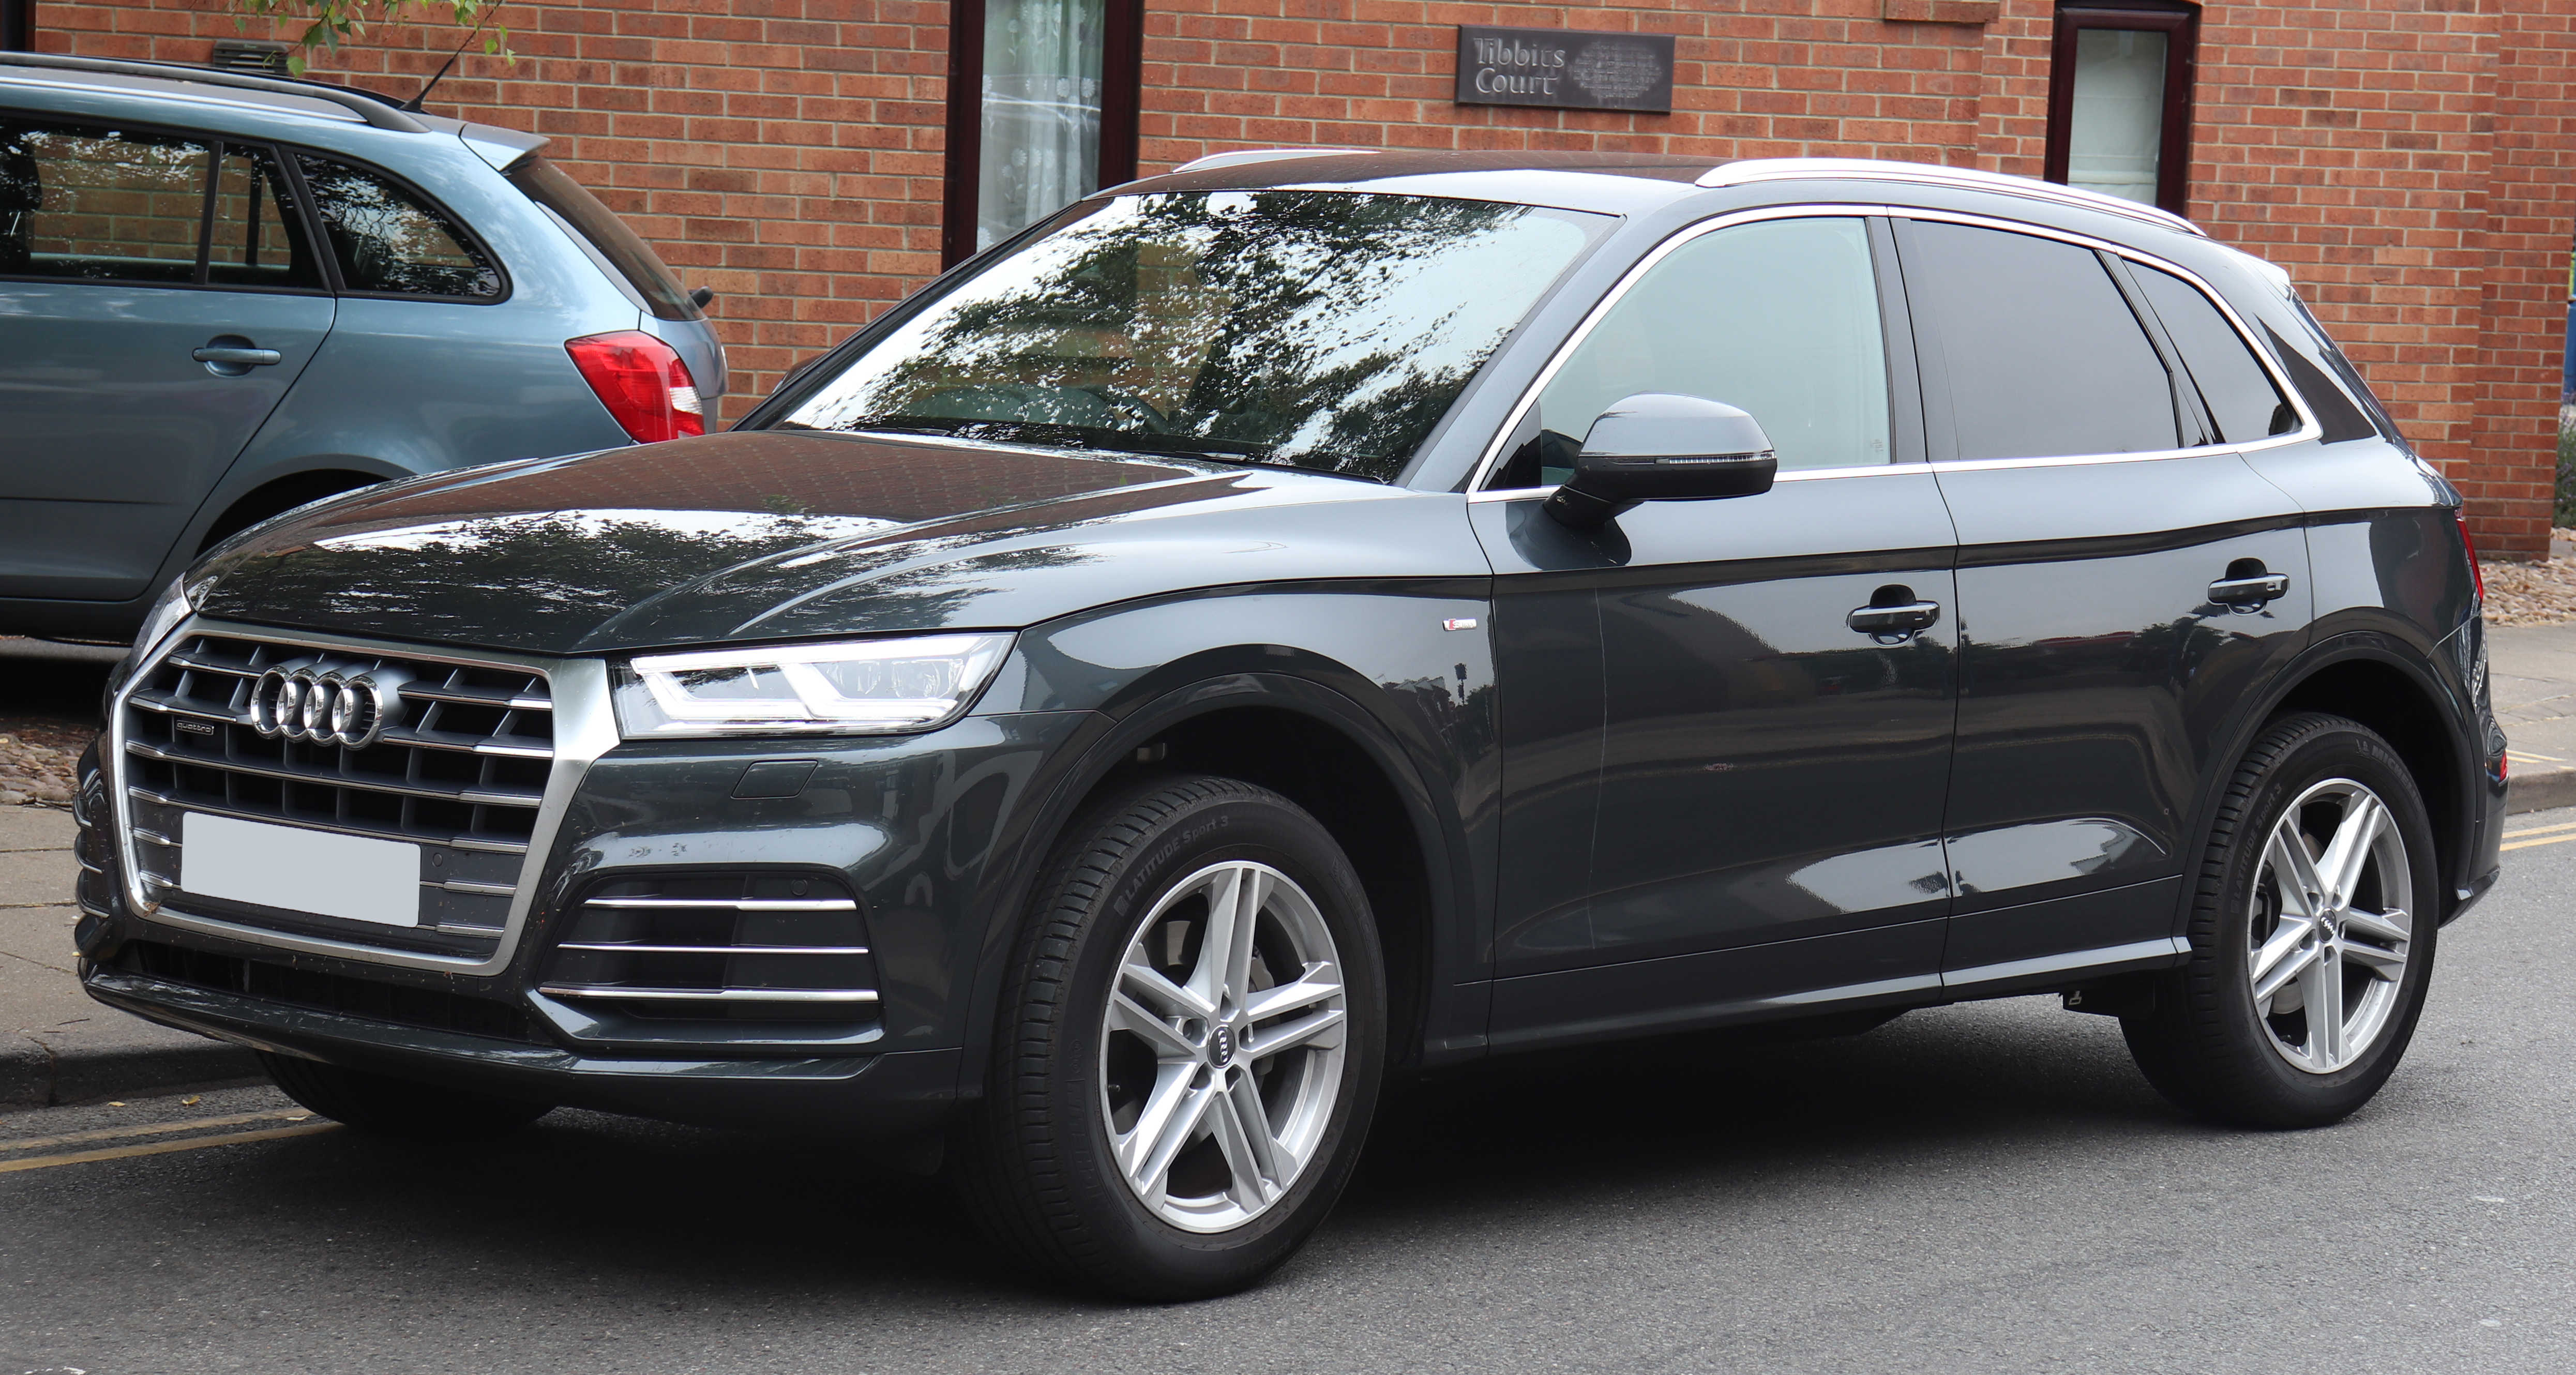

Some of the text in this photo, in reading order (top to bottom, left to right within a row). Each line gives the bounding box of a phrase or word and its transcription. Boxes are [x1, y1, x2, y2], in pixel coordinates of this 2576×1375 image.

[1473, 37, 1566, 68] Tibbits
[1476, 67, 1558, 95] Court
[177, 722, 212, 733] quattro
[2234, 783, 2282, 900] LATITUDE Sport 3
[1125, 815, 1229, 901] LATITUDE Sport 3
